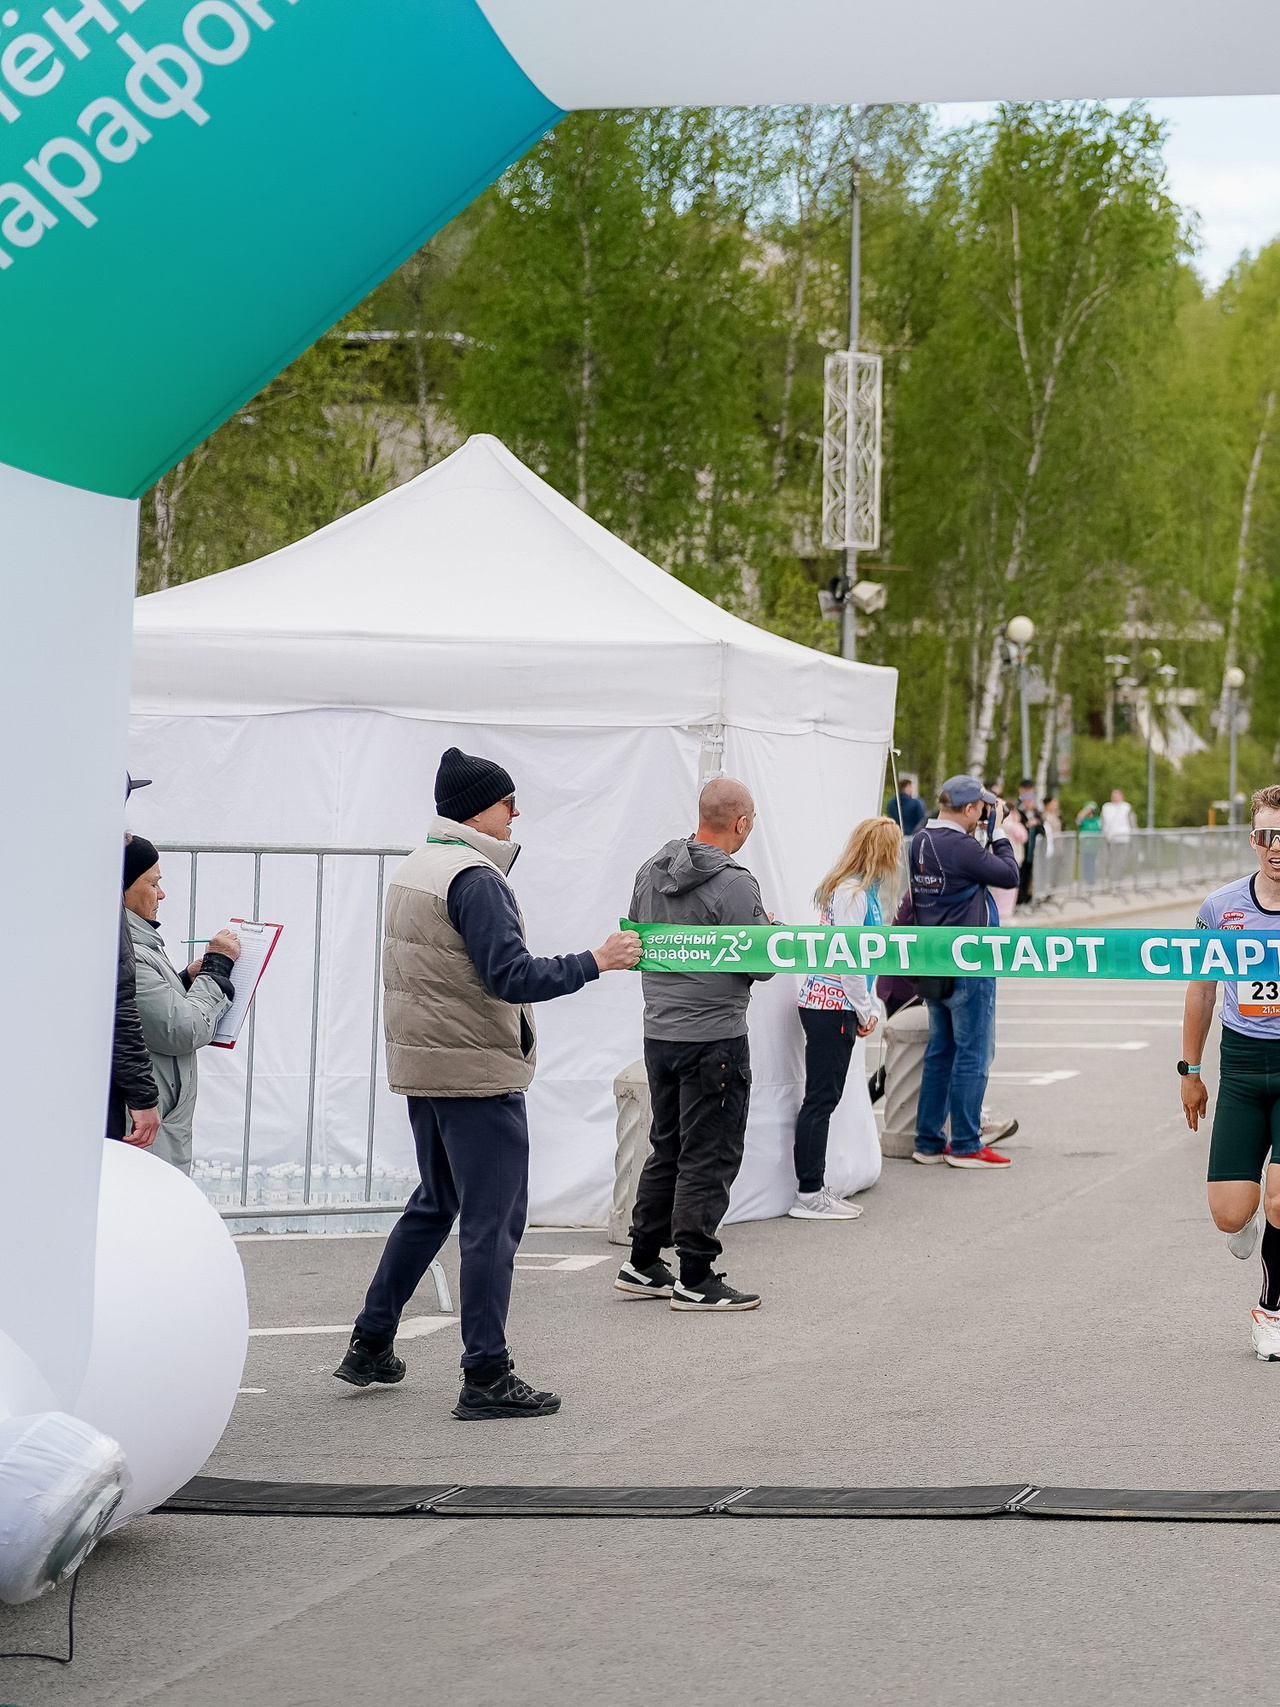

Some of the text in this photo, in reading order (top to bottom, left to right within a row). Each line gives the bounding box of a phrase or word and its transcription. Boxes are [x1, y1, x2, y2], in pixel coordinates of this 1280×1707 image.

[0, 0, 299, 270] арафо
[646, 930, 718, 945] зелёный
[766, 931, 918, 969] СТАРТ
[951, 934, 1105, 973] СТАРТ
